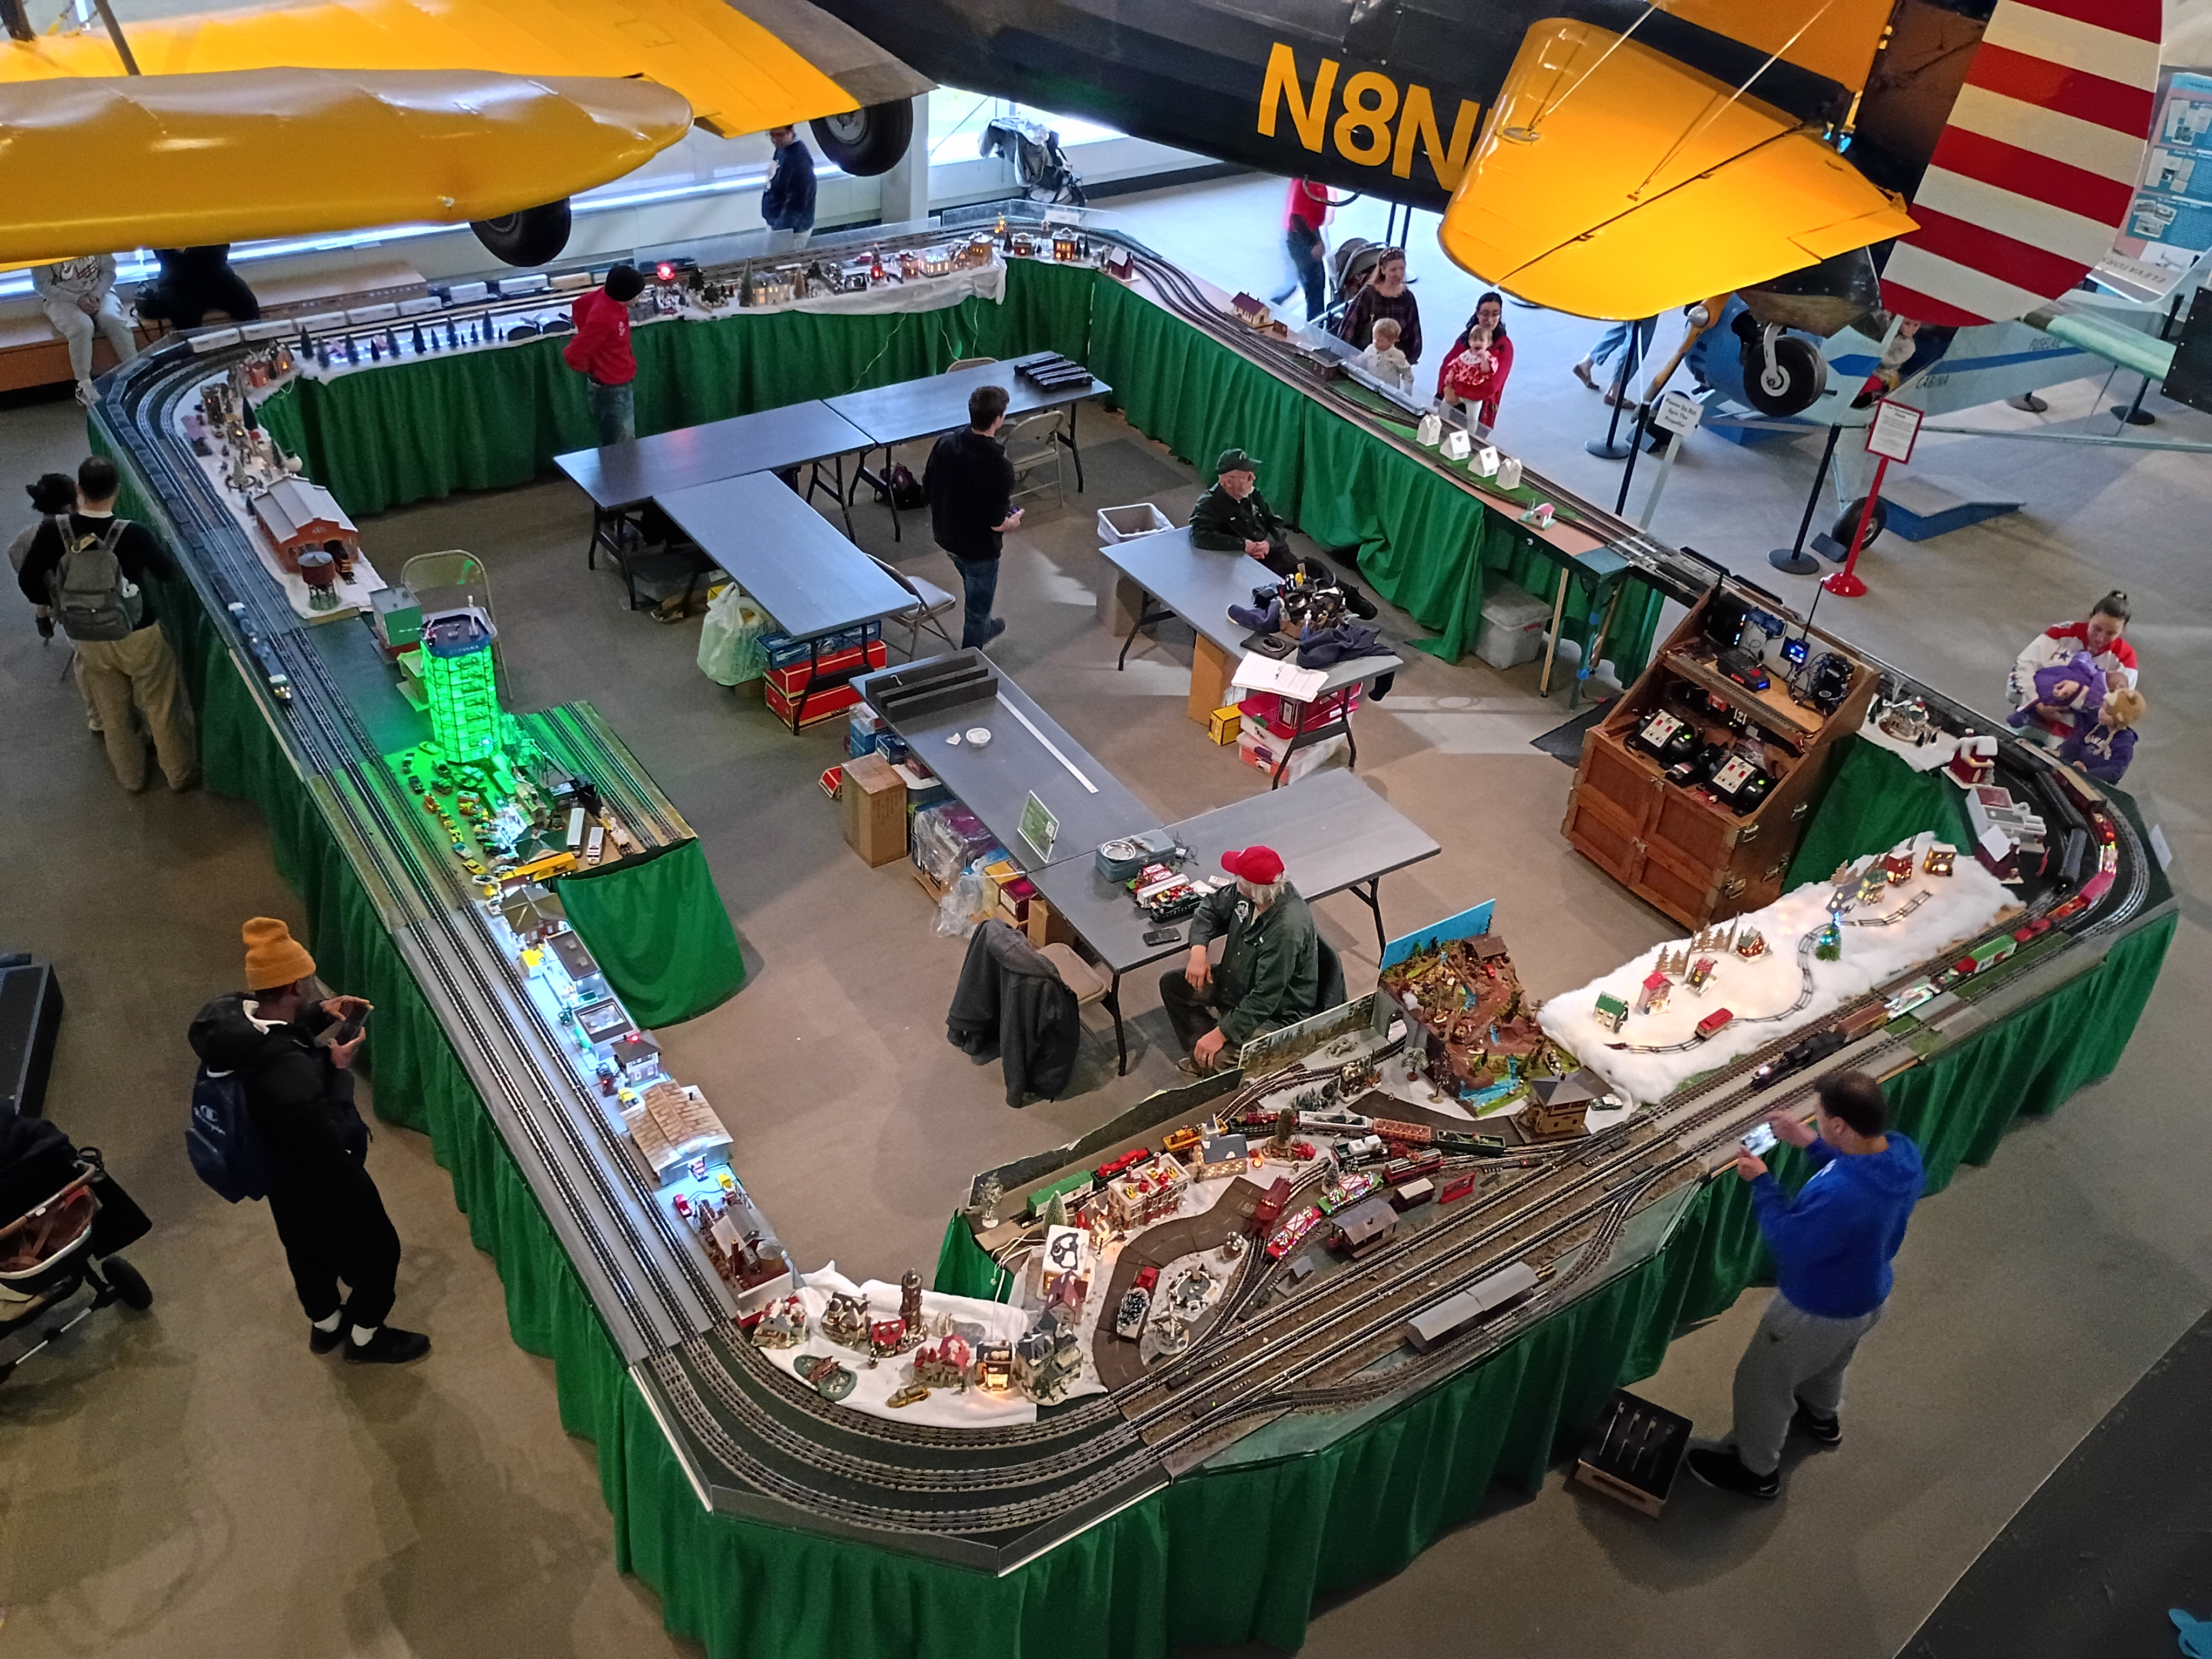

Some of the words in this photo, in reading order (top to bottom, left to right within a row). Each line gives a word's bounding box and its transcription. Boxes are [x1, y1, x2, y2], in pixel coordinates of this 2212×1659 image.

[1257, 41, 1494, 192] N8N
[1665, 399, 1680, 408] Please
[1665, 416, 1685, 427] Propeller
